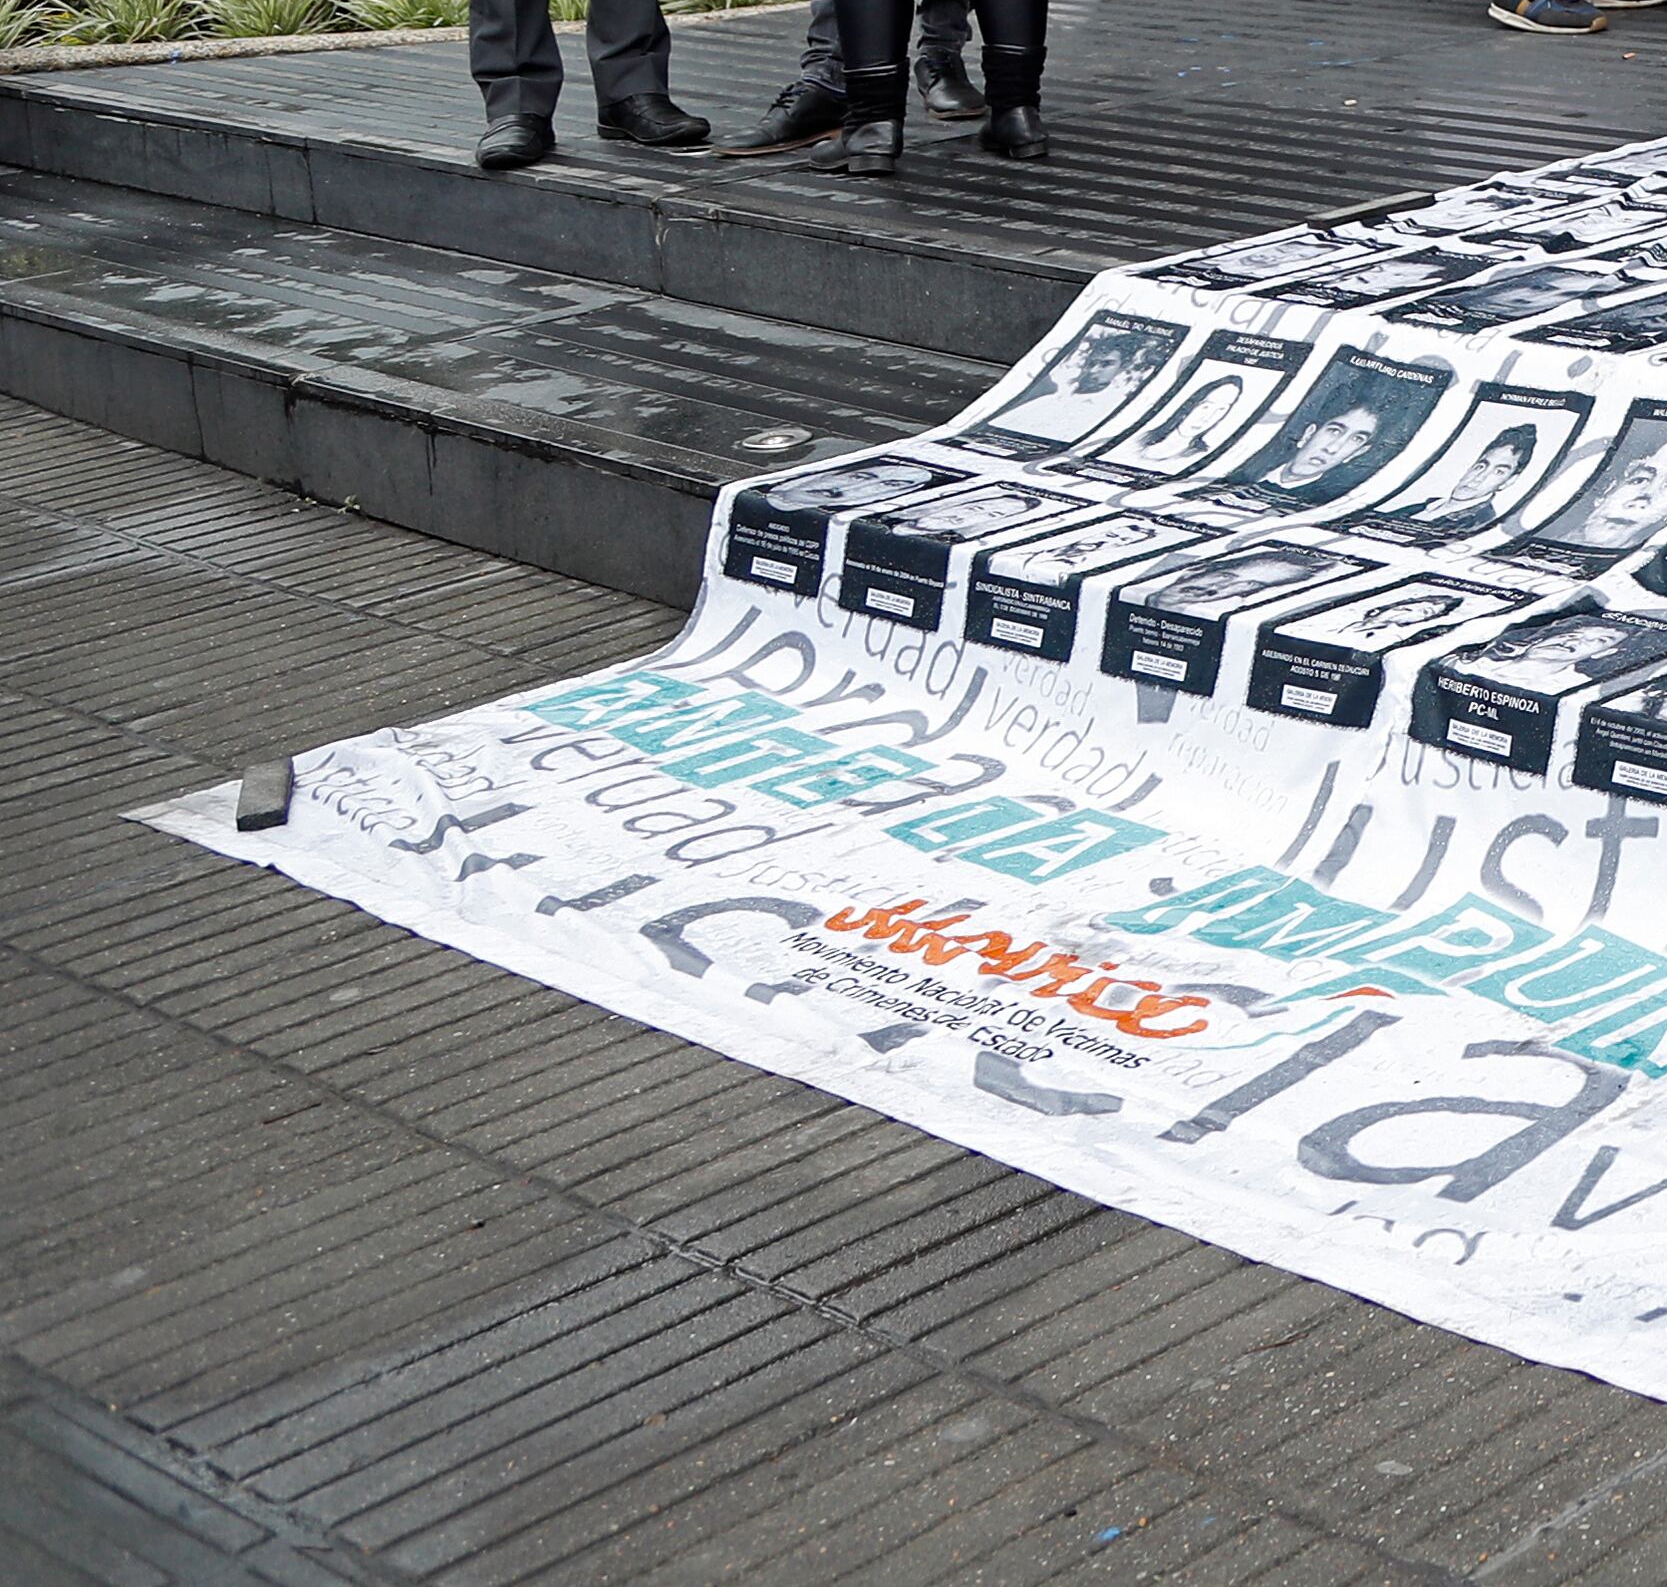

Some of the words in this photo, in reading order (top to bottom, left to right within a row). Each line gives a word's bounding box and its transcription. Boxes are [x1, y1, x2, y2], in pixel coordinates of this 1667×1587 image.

[983, 685, 1149, 801] verdad
[1437, 675, 1491, 702] HERIBERTO
[1490, 691, 1541, 715] ESPINOZA
[499, 724, 835, 870] verdad
[548, 677, 916, 805] ANTE
[913, 803, 1117, 878] LA
[779, 930, 912, 986] Movimiento
[909, 974, 1007, 1017] Nacional
[1007, 1004, 1045, 1034] de
[1045, 1016, 1155, 1072] Víctimas
[791, 965, 828, 985] de
[935, 1013, 971, 1034] de
[965, 1025, 1055, 1065] Estado
